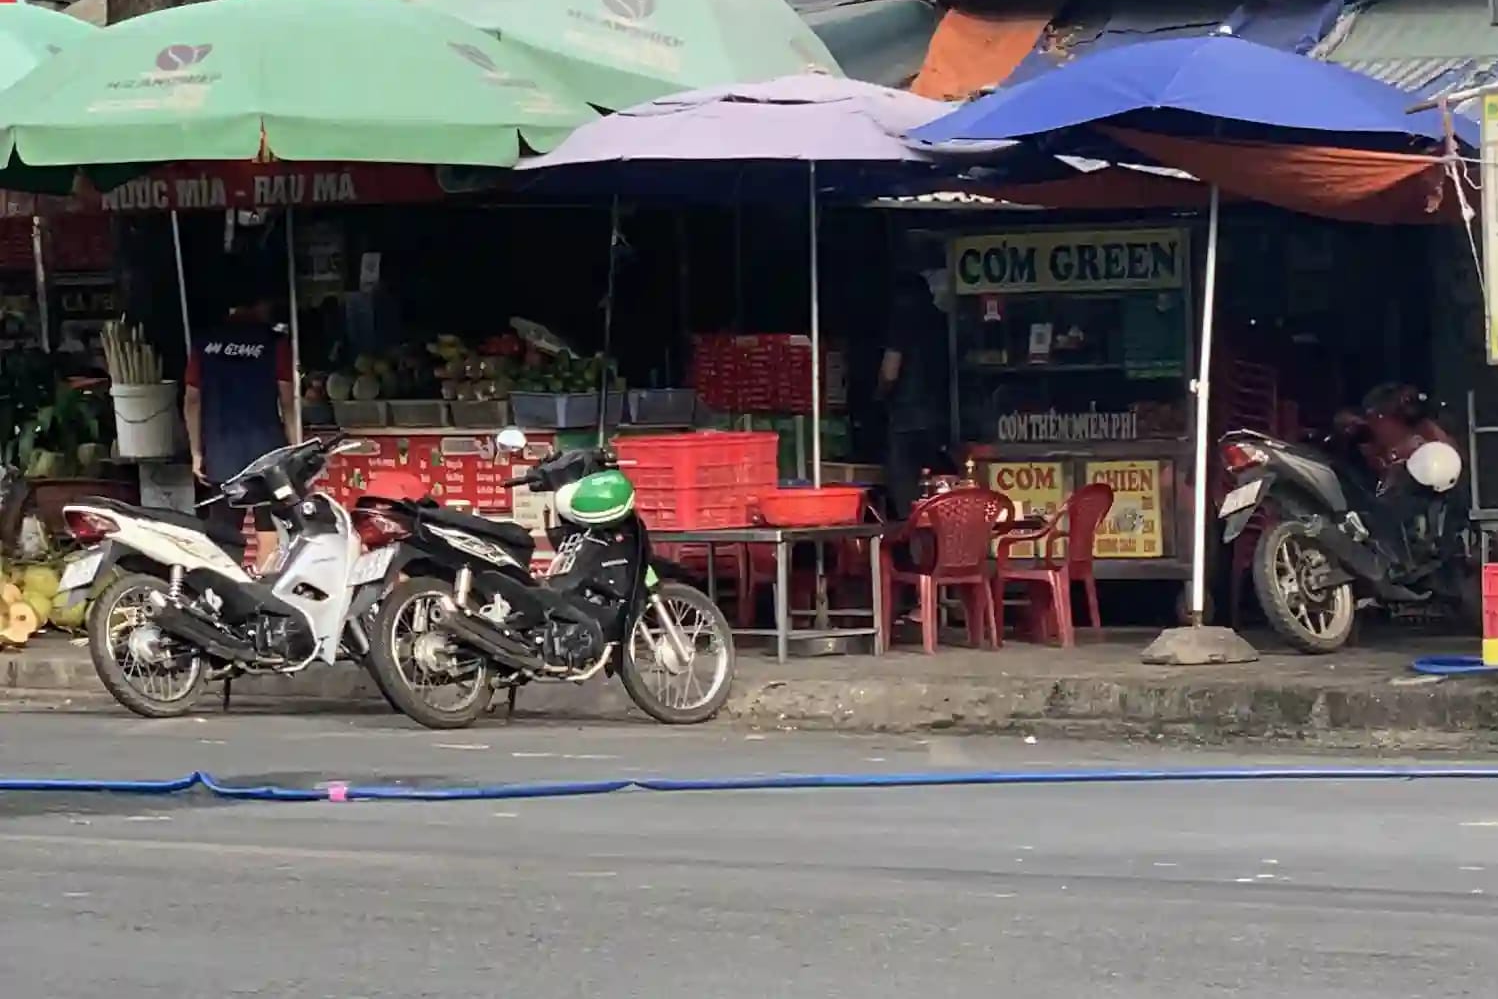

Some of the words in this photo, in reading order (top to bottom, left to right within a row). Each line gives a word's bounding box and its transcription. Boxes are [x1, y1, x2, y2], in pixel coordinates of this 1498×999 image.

[959, 241, 1036, 285] CƠM
[1049, 241, 1177, 281] GREEN
[997, 462, 1056, 491] CƠM
